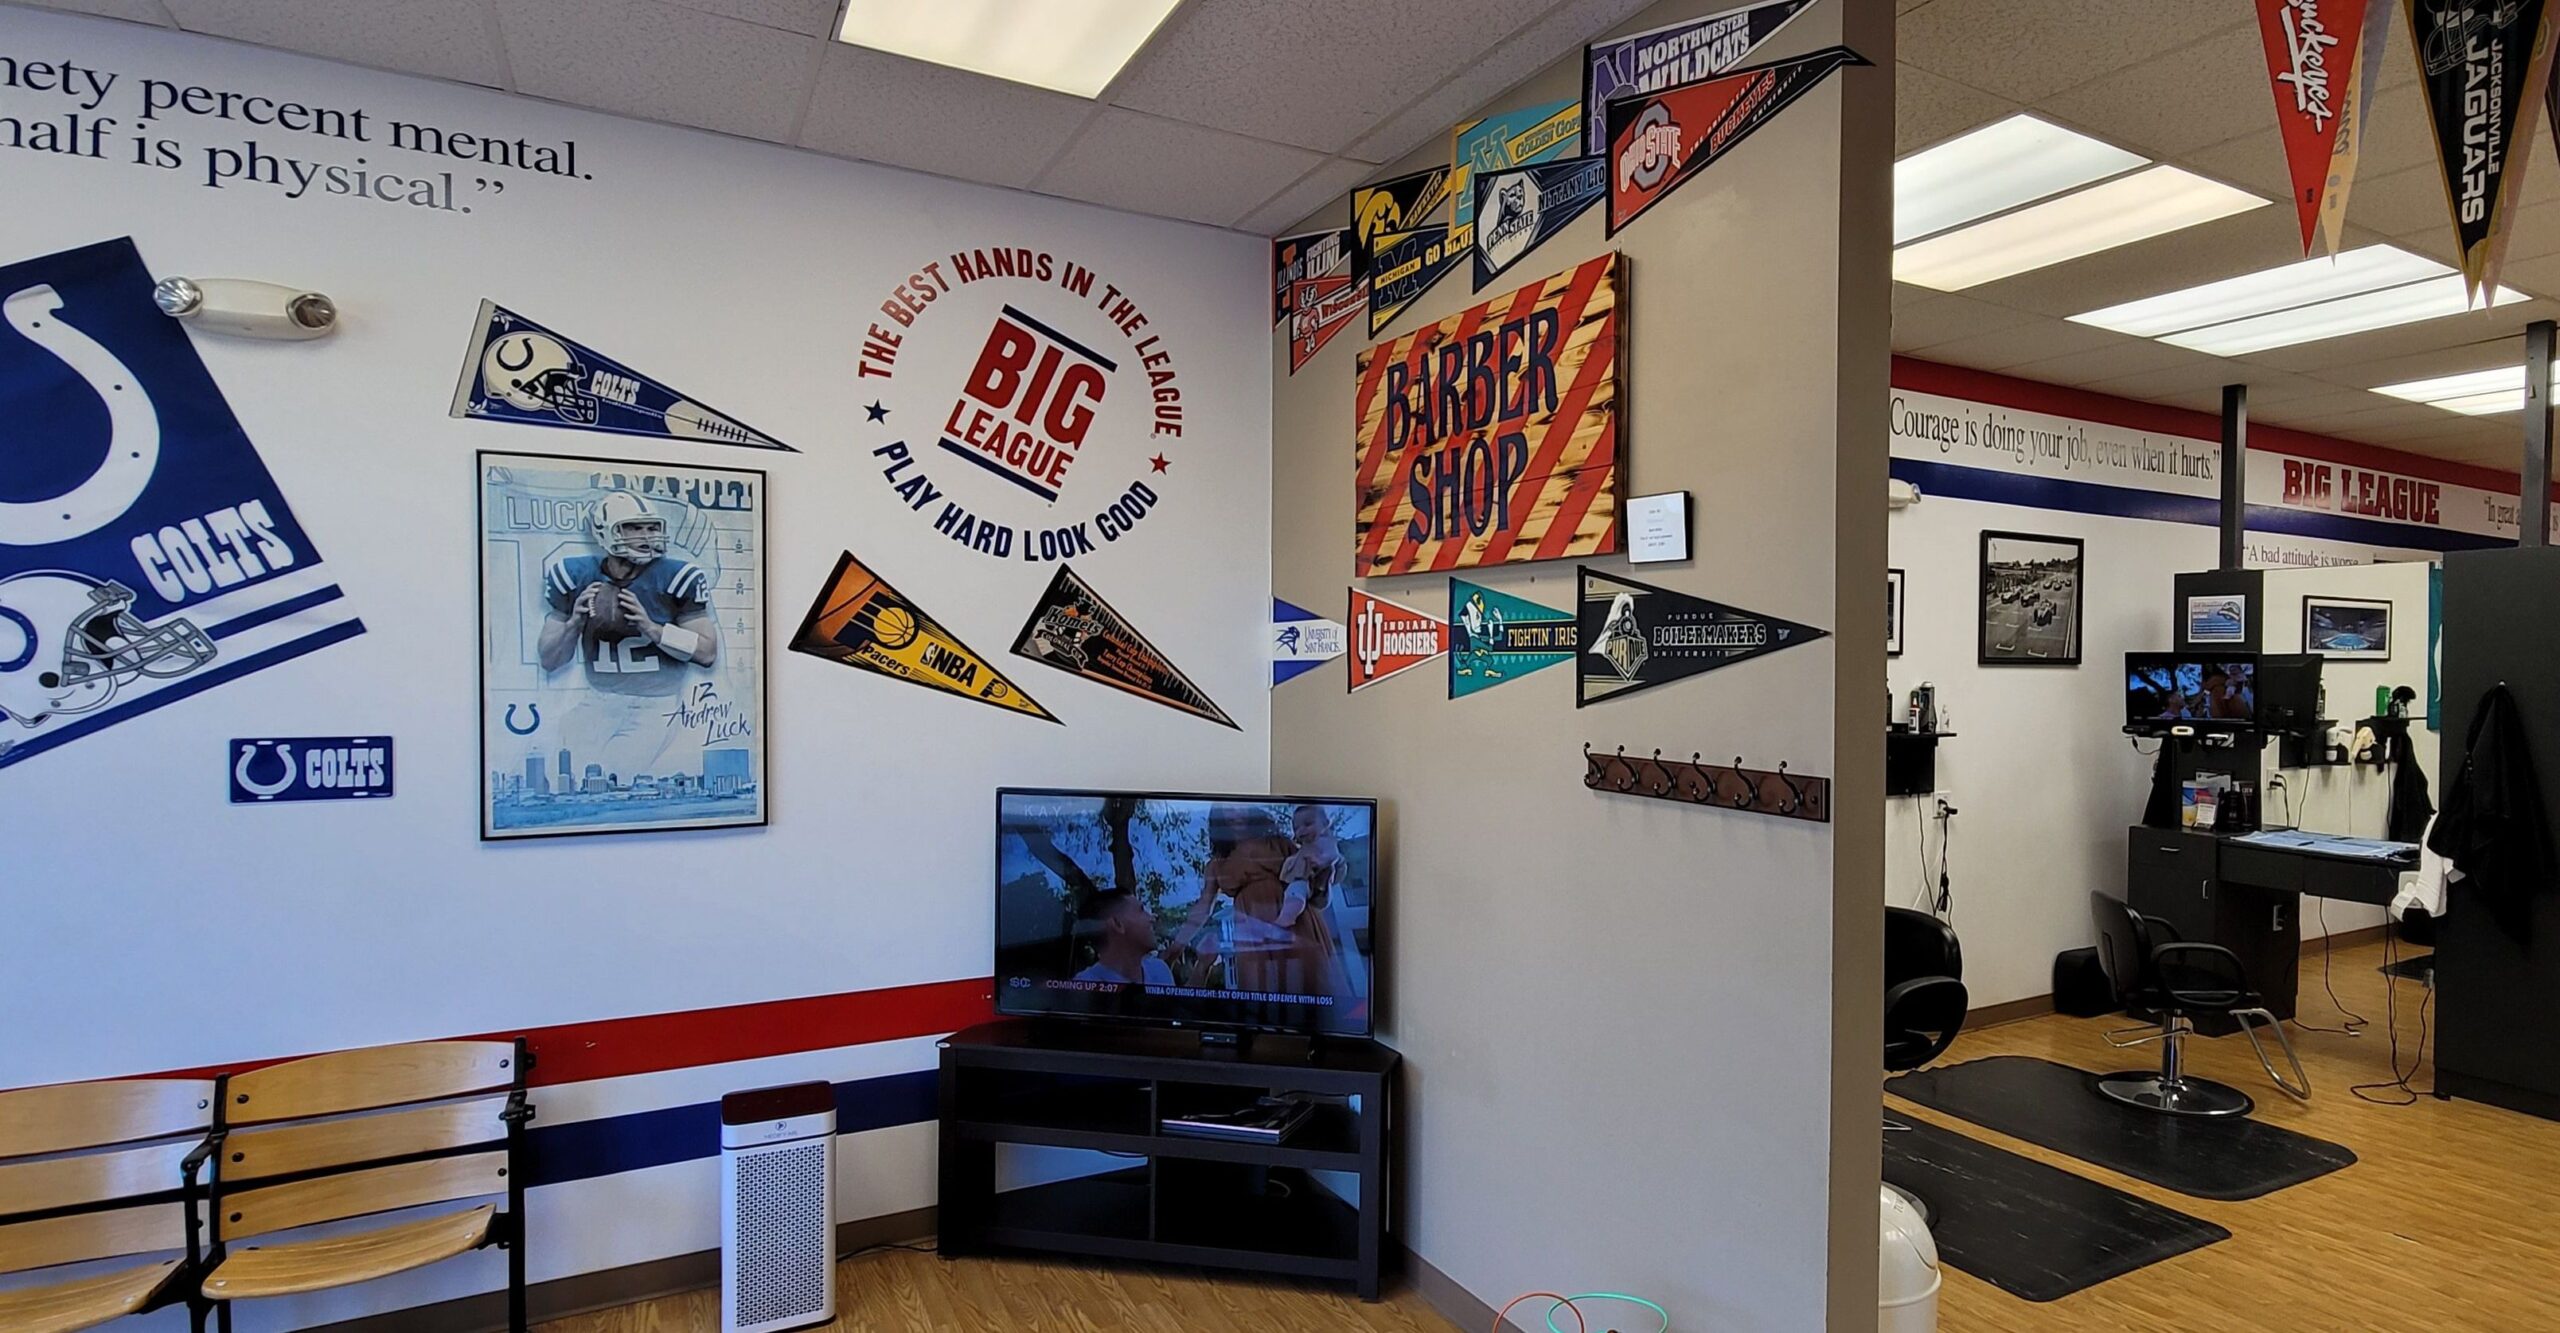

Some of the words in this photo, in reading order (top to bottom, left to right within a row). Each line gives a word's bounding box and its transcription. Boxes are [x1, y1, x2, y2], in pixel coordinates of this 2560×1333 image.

[1638, 11, 1749, 73] NORTHWESTERN
[1638, 26, 1750, 94] WILDCATS
[1710, 68, 1776, 155] BUCKEYES
[2487, 39, 2503, 175] JACKSONVILLE
[131, 123, 182, 169] is
[139, 78, 372, 142] percent
[390, 121, 593, 180] mental.
[2462, 37, 2490, 224] JAGUARS
[1537, 172, 1583, 213] NITTANY
[1487, 221, 1511, 249] PENN
[1509, 210, 1534, 234] STATE
[950, 247, 1054, 284] HANDS
[1307, 244, 1340, 280] ILLINI
[1380, 262, 1415, 284] MICHIGAN
[1424, 244, 1440, 266] GO
[880, 261, 950, 328] BEST
[1060, 260, 1096, 298] IN
[1097, 283, 1149, 338] THE
[858, 322, 903, 379] THE
[590, 370, 641, 405] COLTS
[963, 317, 1106, 451] BIG
[1134, 335, 1183, 439] LEAGUE
[1387, 306, 1560, 452] BARBER
[943, 398, 1075, 489] LEAGUE
[1890, 397, 1960, 453] Courage
[1965, 408, 1978, 447] is
[1982, 413, 2026, 463] doing
[2030, 428, 2063, 465] your
[2064, 425, 2092, 470] job,
[2096, 439, 2127, 468] even
[2131, 438, 2165, 473] when
[2168, 442, 2178, 475] it
[872, 440, 942, 512] PLAY
[933, 501, 1013, 559] HARD
[1023, 521, 1096, 562] LOOK
[1095, 480, 1158, 542] GOOD
[1408, 431, 1529, 544] SHOP
[2283, 459, 2331, 509] BIG
[2341, 469, 2440, 524] LEAGUE
[506, 496, 597, 530] LUCK
[130, 499, 294, 602] COLTS
[2261, 546, 2280, 564] bad
[2282, 548, 2320, 567] attitude
[2321, 551, 2329, 567] is
[1045, 604, 1104, 637] Komets
[1384, 620, 1437, 631] INDIANA
[1653, 623, 1767, 647] BOILERMAKERS
[1667, 612, 1714, 621] PURDUE
[862, 643, 910, 676] Pacers
[1383, 631, 1438, 656] HOOSIERS
[1607, 637, 1646, 671] PURDUE
[1653, 650, 1729, 658] UNIVERSITY
[930, 645, 978, 688] NBA
[692, 682, 718, 705] 12
[662, 700, 733, 730] Andrew
[701, 714, 751, 746] Luck
[305, 747, 384, 788] COLTS
[1046, 979, 1083, 991] COMING
[1084, 982, 1096, 991] UP
[1099, 984, 1118, 993] 2:07
[1145, 986, 1164, 996] WNBA
[1165, 987, 1194, 997] OPENING
[1217, 990, 1231, 999] SKY
[1231, 991, 1250, 1000] OPEN
[1251, 992, 1267, 1002] TITLE
[1268, 993, 1297, 1003] DEFENSE
[1298, 995, 1315, 1005] WITH
[1316, 996, 1333, 1006] LOSS
